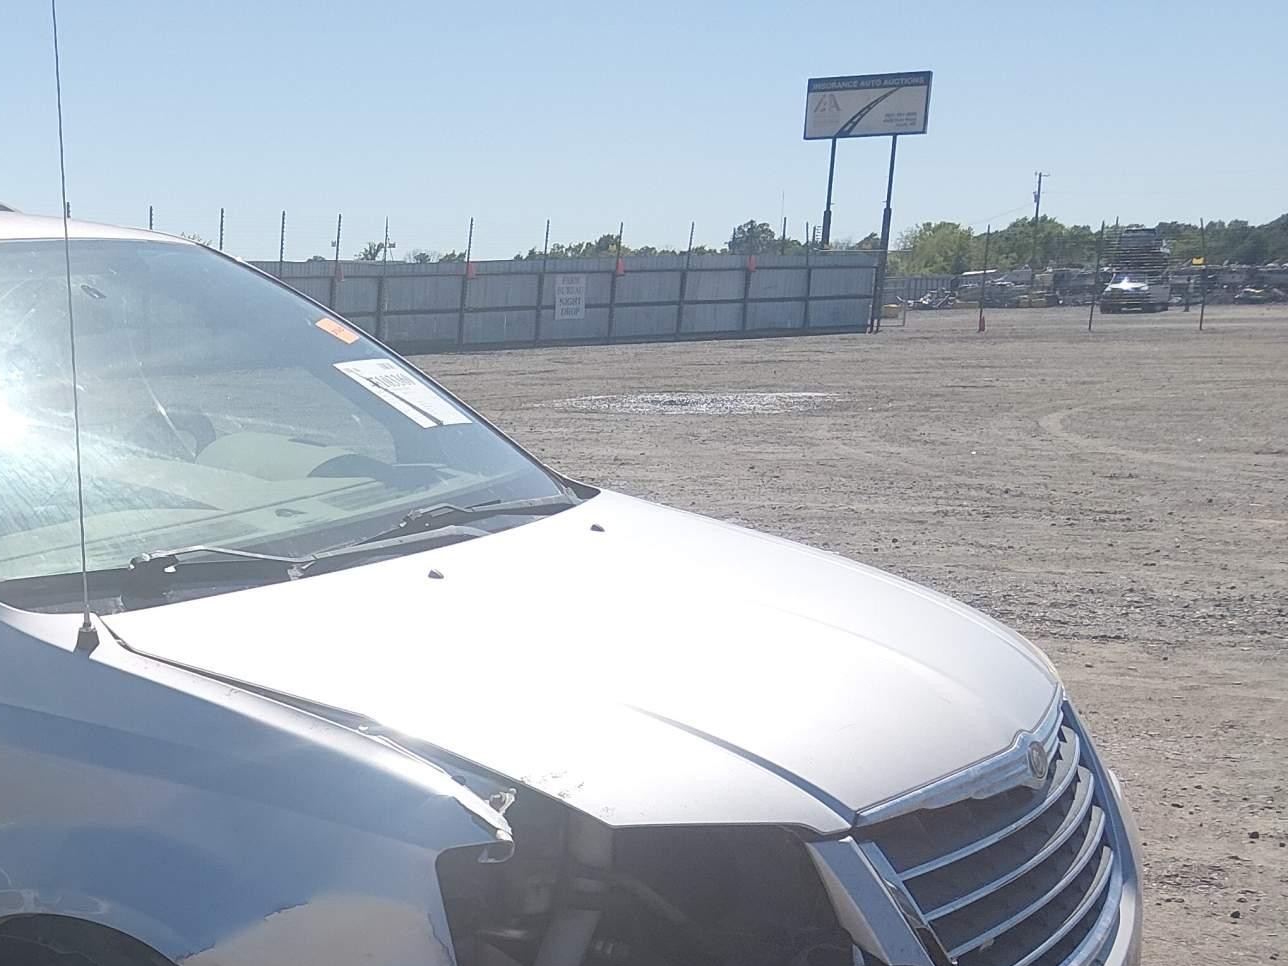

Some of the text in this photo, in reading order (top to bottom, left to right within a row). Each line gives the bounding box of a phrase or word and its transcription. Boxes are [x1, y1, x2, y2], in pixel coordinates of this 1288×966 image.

[813, 77, 924, 90] INSURANCE AUTO AUCTIONS
